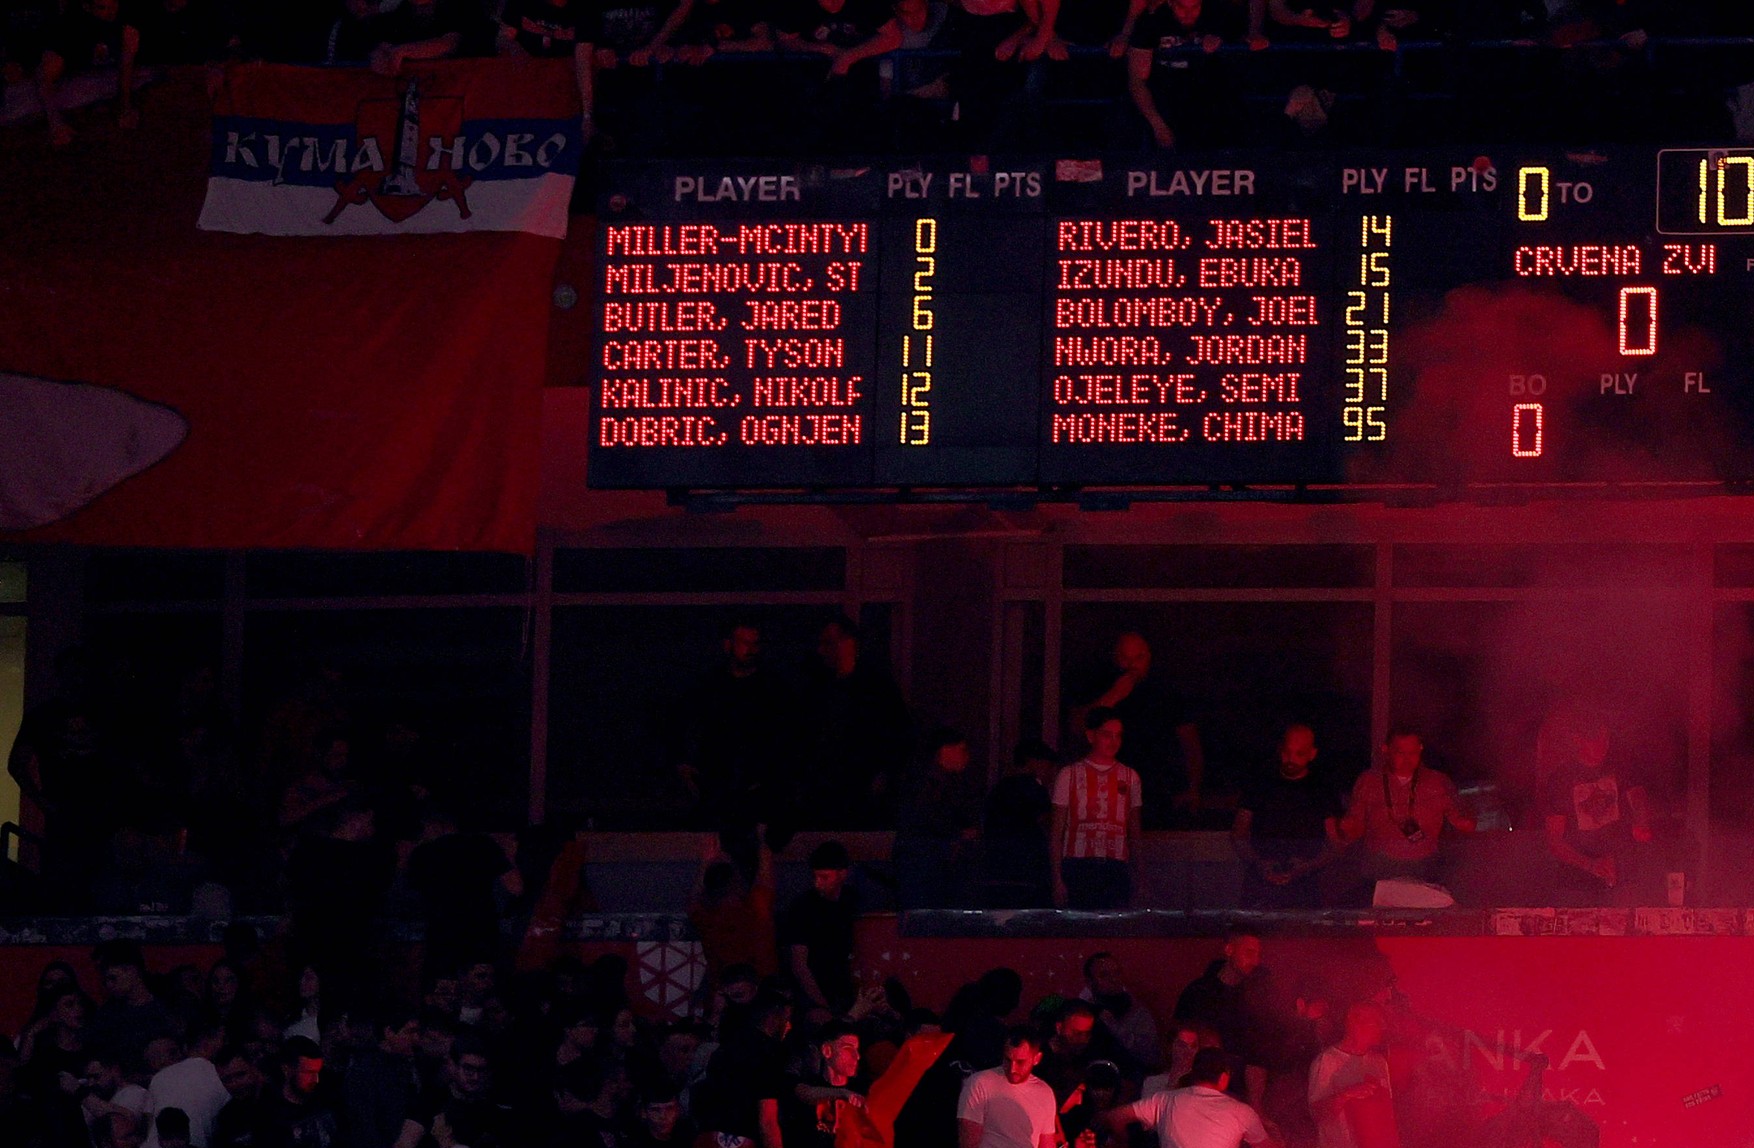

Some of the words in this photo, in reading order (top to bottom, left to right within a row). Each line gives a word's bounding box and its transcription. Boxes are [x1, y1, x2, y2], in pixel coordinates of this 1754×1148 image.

[675, 176, 800, 202] PLAYER
[888, 172, 934, 198] PLY
[949, 173, 979, 198] FL
[994, 172, 1041, 198] PTS
[1127, 169, 1255, 196] PLAYER
[1342, 168, 1387, 194] PLY
[1405, 167, 1436, 193] FL
[1451, 166, 1497, 193] PTS
[1517, 166, 1550, 222] 0
[1557, 182, 1593, 204] TO
[915, 218, 937, 254] 0
[1058, 220, 1192, 251] RIVERO,
[1204, 218, 1317, 250] JASIEL
[1361, 215, 1392, 248] 14
[913, 256, 935, 292] 2
[1057, 258, 1187, 290] IZUNDU,
[1199, 257, 1301, 289] EBUKA
[1360, 252, 1391, 287] 15
[1514, 244, 1642, 277] CRVENA
[605, 261, 814, 295] MILJENOVIC,
[826, 261, 863, 292] ST
[603, 301, 729, 333] BUTLER,
[740, 299, 841, 331] JARED
[912, 295, 934, 331] 6
[1055, 296, 1234, 329] BOLOMBOY,
[1345, 290, 1390, 326] 21
[1617, 285, 1659, 357] 0
[602, 338, 731, 371] CARTER,
[744, 338, 845, 369] TYSON
[902, 334, 933, 368] 11
[1054, 335, 1172, 367] NWORA,
[1185, 334, 1307, 366] JORDAN
[1345, 329, 1389, 365] 33
[601, 377, 742, 409] KALINIC,
[901, 371, 932, 407] 12
[1053, 373, 1208, 405] OJELEYE,
[1220, 372, 1301, 404] SEMI
[1345, 367, 1388, 403] 37
[1509, 374, 1547, 396] BO
[1600, 373, 1638, 395] PLY
[1684, 372, 1711, 394] FL
[599, 415, 729, 447] DOBRIC,
[740, 414, 862, 446] OGNJEN
[899, 410, 930, 446] 13
[1052, 412, 1190, 444] MONEKE,
[1203, 411, 1305, 442] CHIMA
[1343, 406, 1387, 442] 95
[1511, 401, 1544, 458] 0
